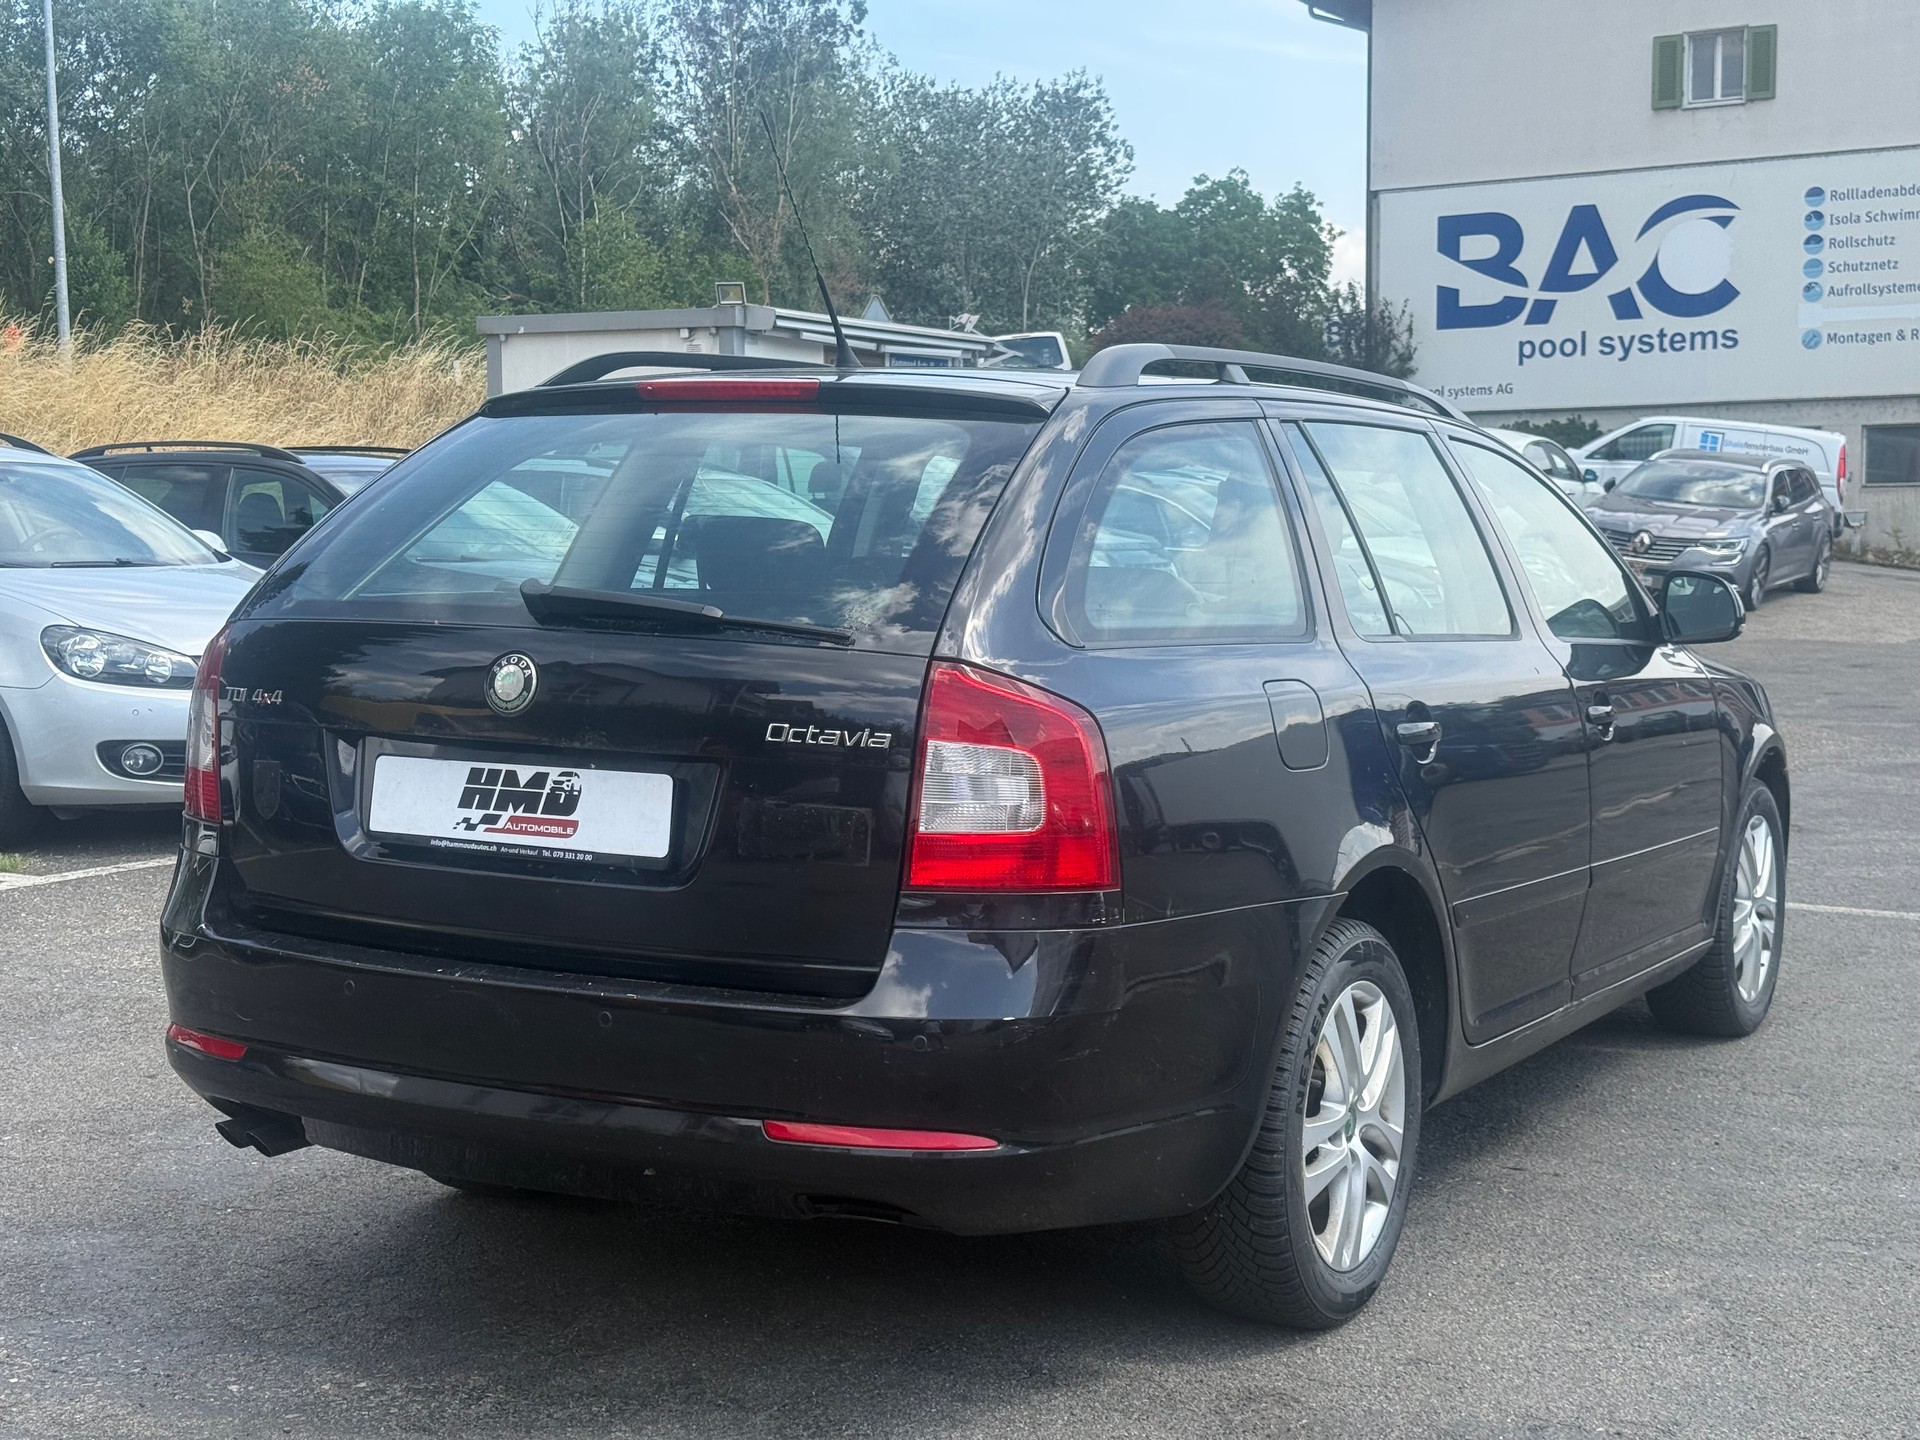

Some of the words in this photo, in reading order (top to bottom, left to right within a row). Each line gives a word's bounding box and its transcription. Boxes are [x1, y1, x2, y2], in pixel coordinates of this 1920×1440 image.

[1829, 212, 1861, 226] Isola
[1828, 235, 1896, 249] Rollschutz
[1436, 194, 1741, 330] BAC
[1827, 259, 1900, 274] Schutznetz
[1826, 332, 1892, 346] Montagen
[1895, 328, 1906, 342] &
[1518, 331, 1587, 366] pool
[1598, 327, 1740, 361] systems
[1447, 386, 1493, 400] systems
[1496, 383, 1514, 395] AG
[225, 686, 248, 703] TDI
[251, 688, 282, 705] 4x4
[765, 722, 892, 749] Octavia
[504, 821, 574, 835] AUTOMOBILE
[541, 849, 552, 859] Tel.
[552, 850, 564, 860] 079
[564, 852, 576, 861] 331
[576, 853, 584, 861] 20
[584, 853, 593, 862] 00
